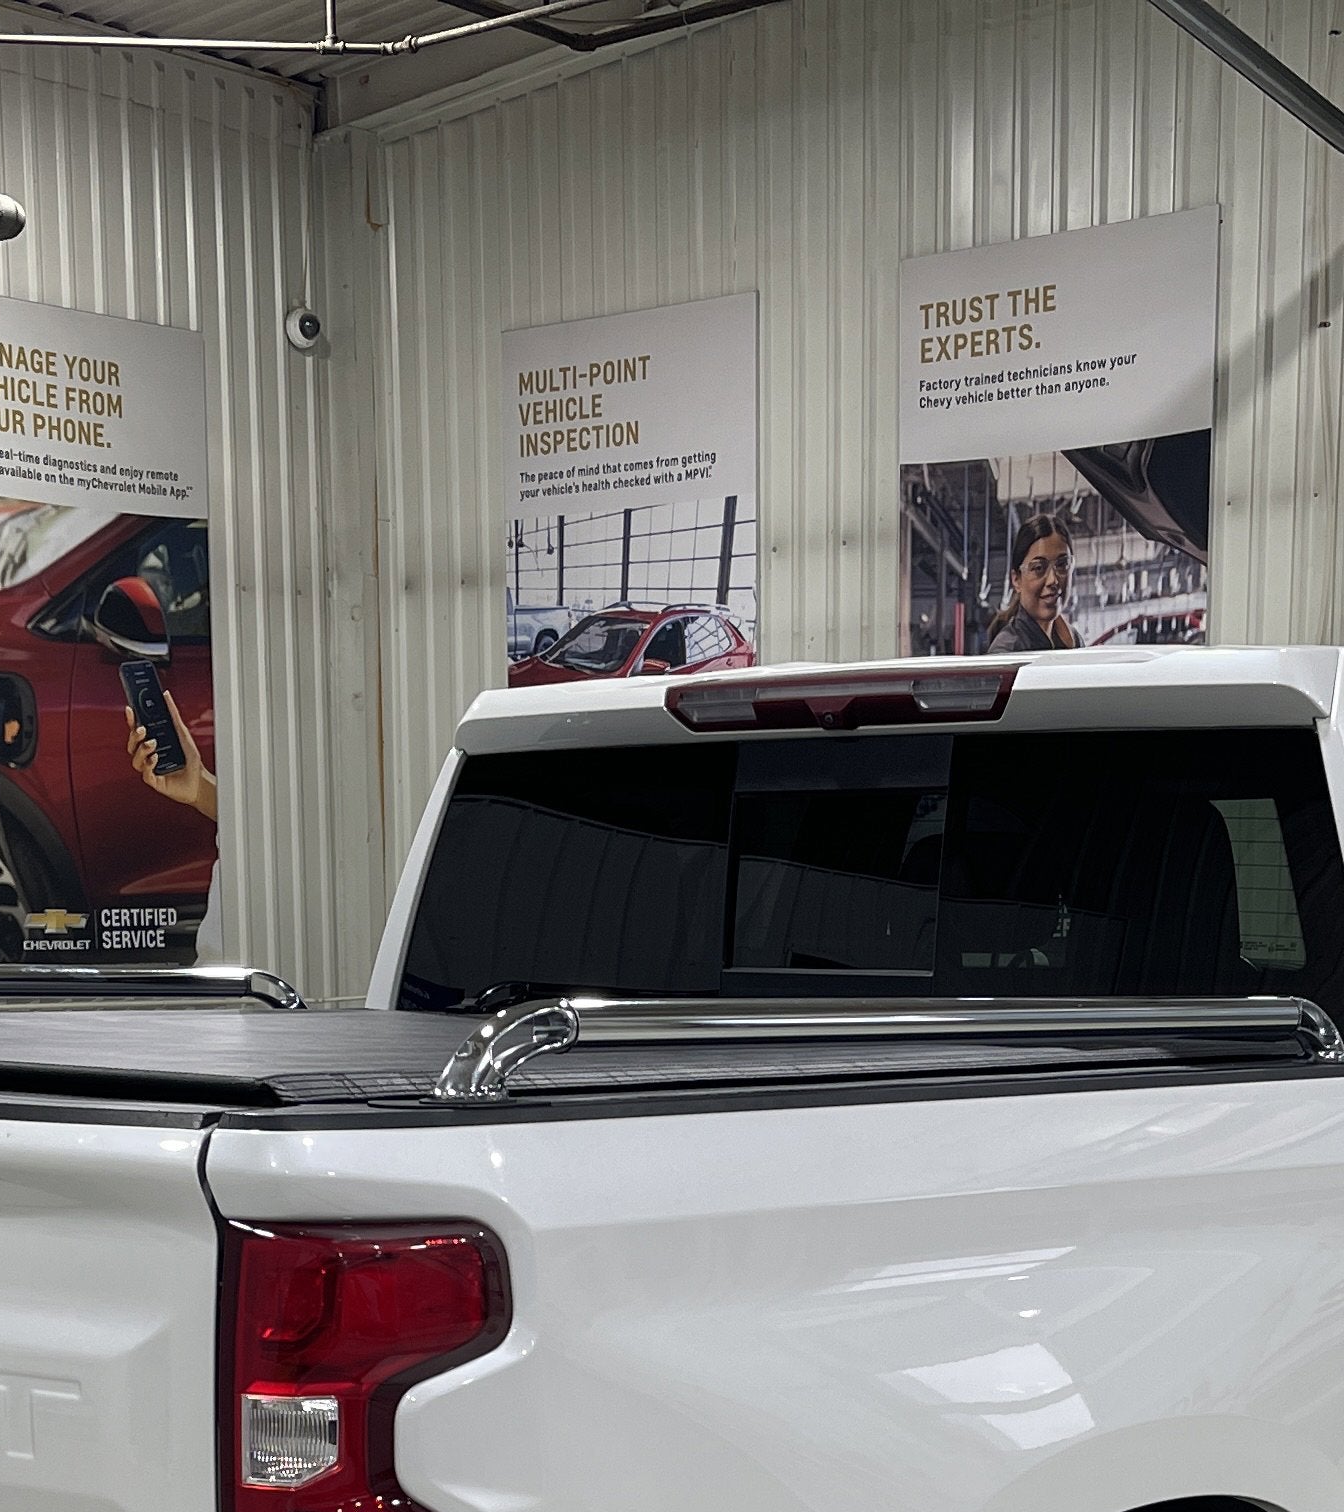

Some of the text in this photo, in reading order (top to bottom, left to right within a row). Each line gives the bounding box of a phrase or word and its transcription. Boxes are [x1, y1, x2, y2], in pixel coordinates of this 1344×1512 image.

[919, 284, 1057, 330] TRUST THE
[920, 323, 1041, 364] EXPERTS.
[63, 353, 120, 387] YOUR
[518, 355, 651, 397] MULTI-POINT
[919, 353, 1137, 392] Factory trained technicians know your
[66, 386, 122, 419] FROM
[919, 375, 1109, 410] Chevy vehicle better than anyone.
[518, 393, 603, 427] VEHICLE
[34, 413, 112, 449] PHONE.
[519, 420, 639, 458] INSPECTION
[43, 454, 98, 473] diagnostics
[100, 463, 117, 475] and
[119, 466, 144, 480] enjoy
[146, 469, 179, 482] remote
[44, 473, 57, 483] on
[58, 472, 75, 486] the
[77, 477, 136, 494] myChevrolet
[138, 483, 167, 497] Mobile
[519, 451, 716, 484] The peace of mind that comes from getting
[519, 488, 540, 502] your
[581, 477, 611, 493] health
[613, 474, 651, 489] checked
[653, 470, 674, 485] with
[676, 472, 682, 482] a
[101, 908, 177, 928] CERTIFIED
[23, 939, 91, 951] CHEVROLET
[102, 929, 166, 949] SERVICE
